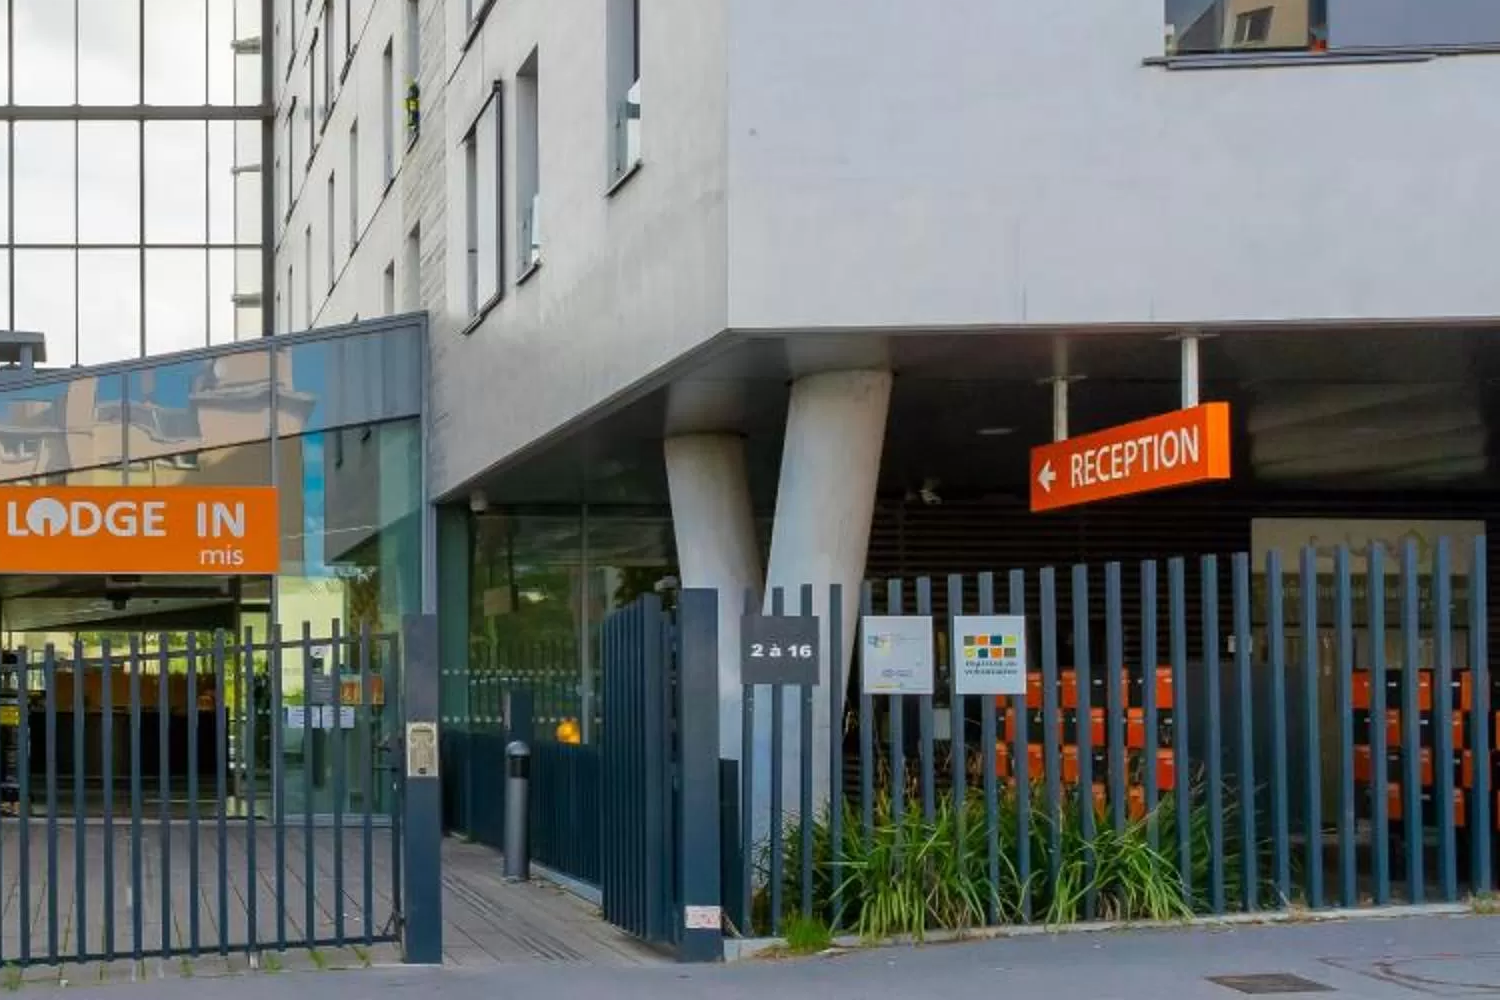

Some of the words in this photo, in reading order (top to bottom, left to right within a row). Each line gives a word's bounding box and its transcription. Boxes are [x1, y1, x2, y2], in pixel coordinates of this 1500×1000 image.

[1071, 424, 1199, 488] RECEPTION
[7, 497, 167, 537] LODGE
[196, 502, 245, 538] IN
[199, 544, 244, 565] mis
[750, 643, 764, 657] 2
[787, 644, 812, 658] 16
